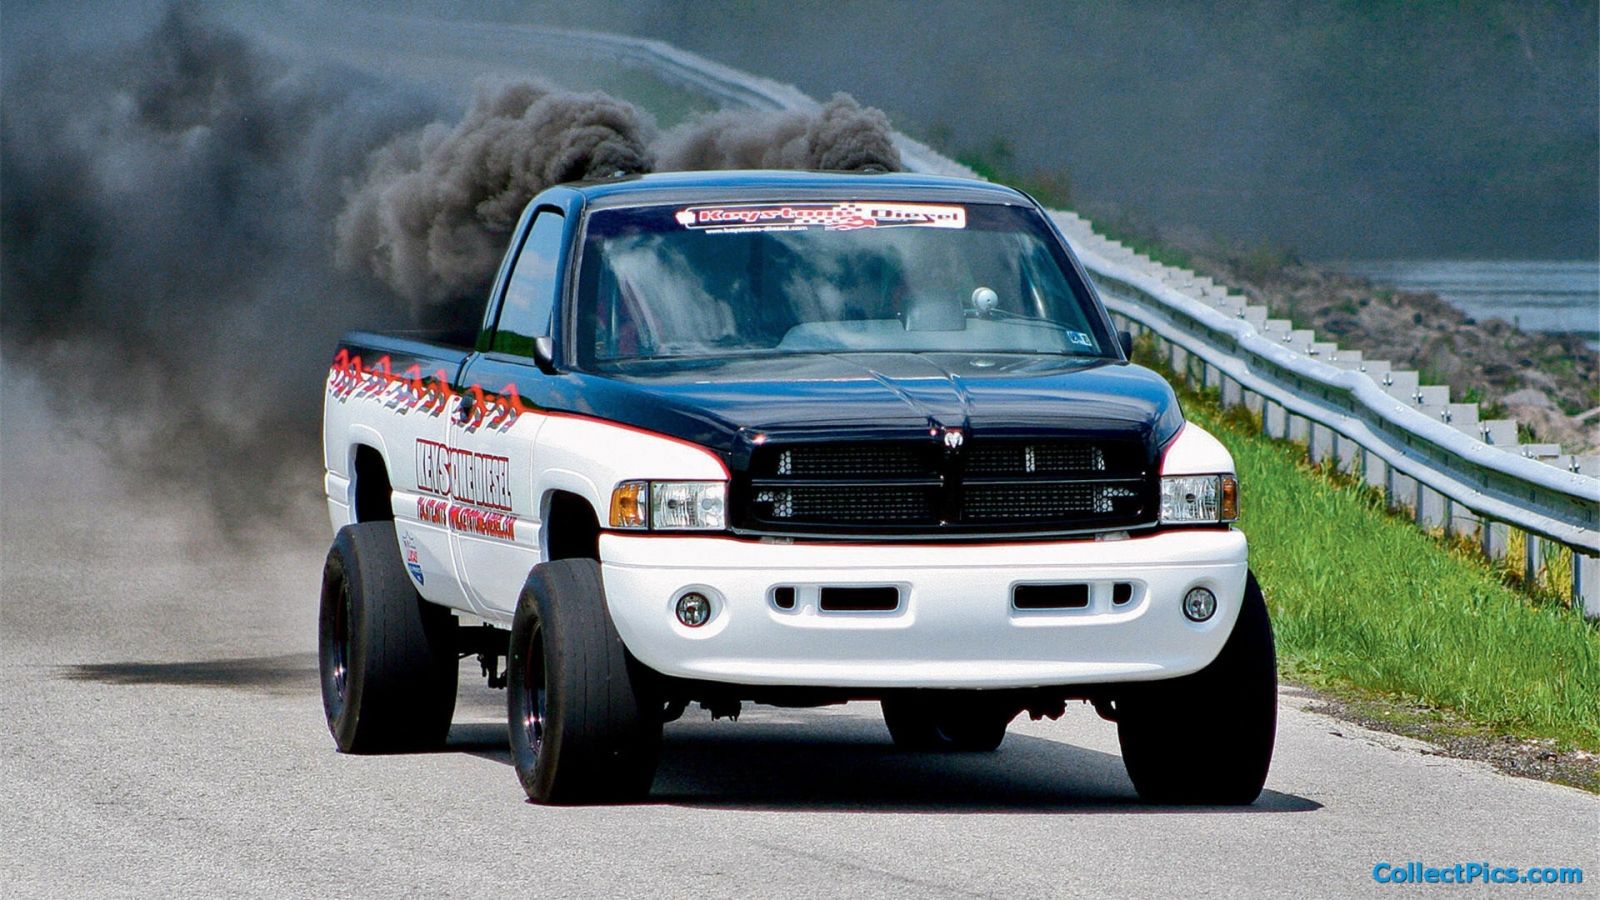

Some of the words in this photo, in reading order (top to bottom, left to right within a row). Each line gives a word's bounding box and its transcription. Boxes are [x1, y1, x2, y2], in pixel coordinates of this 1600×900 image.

[699, 207, 854, 222] Keystone
[869, 208, 960, 223] Diesel
[416, 438, 475, 504] KEYSONE
[473, 452, 512, 511] DIESEL
